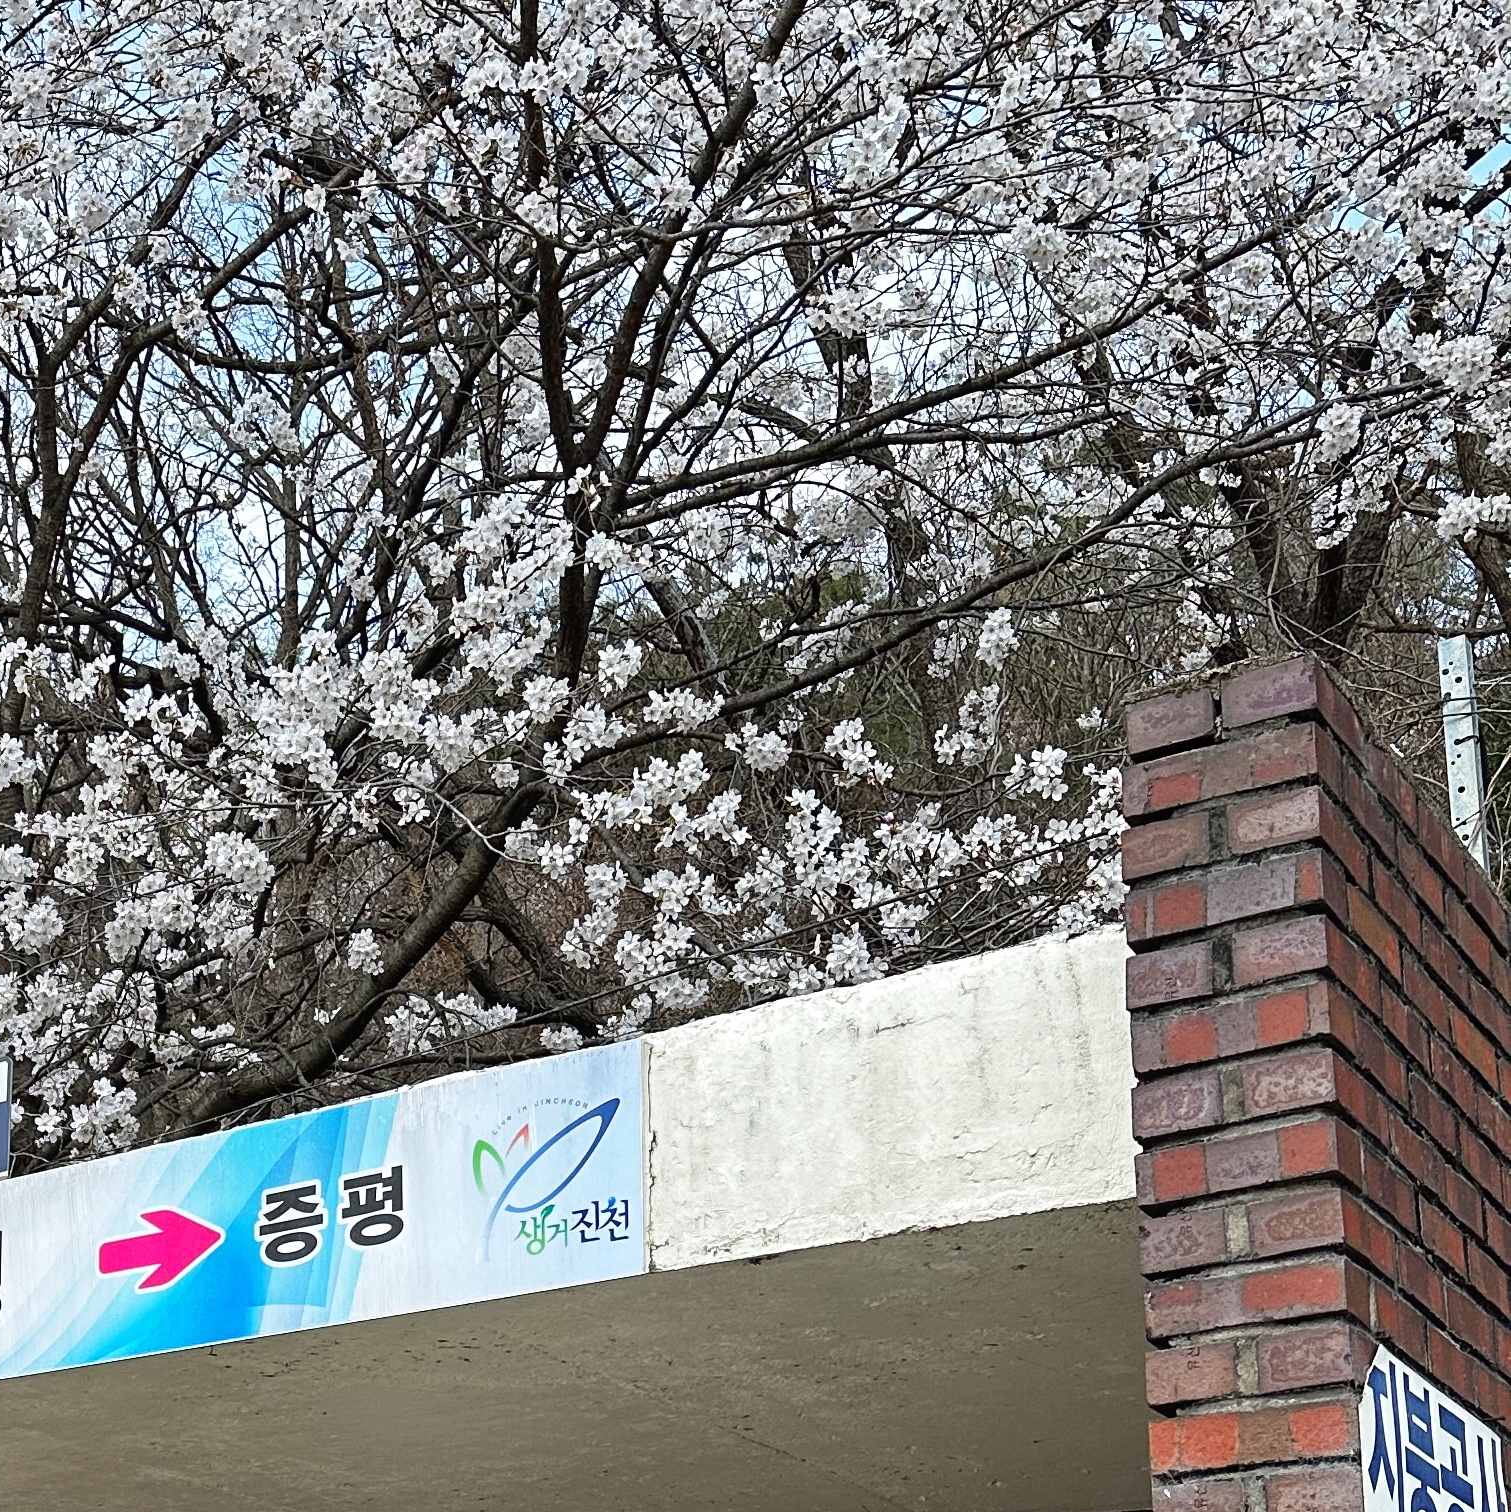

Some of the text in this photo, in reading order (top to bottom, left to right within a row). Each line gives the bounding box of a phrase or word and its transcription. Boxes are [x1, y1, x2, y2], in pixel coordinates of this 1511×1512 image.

[534, 1097, 589, 1110] JINCHEON
[259, 1165, 404, 1263] 증평
[513, 1197, 630, 1256] 생거진천
